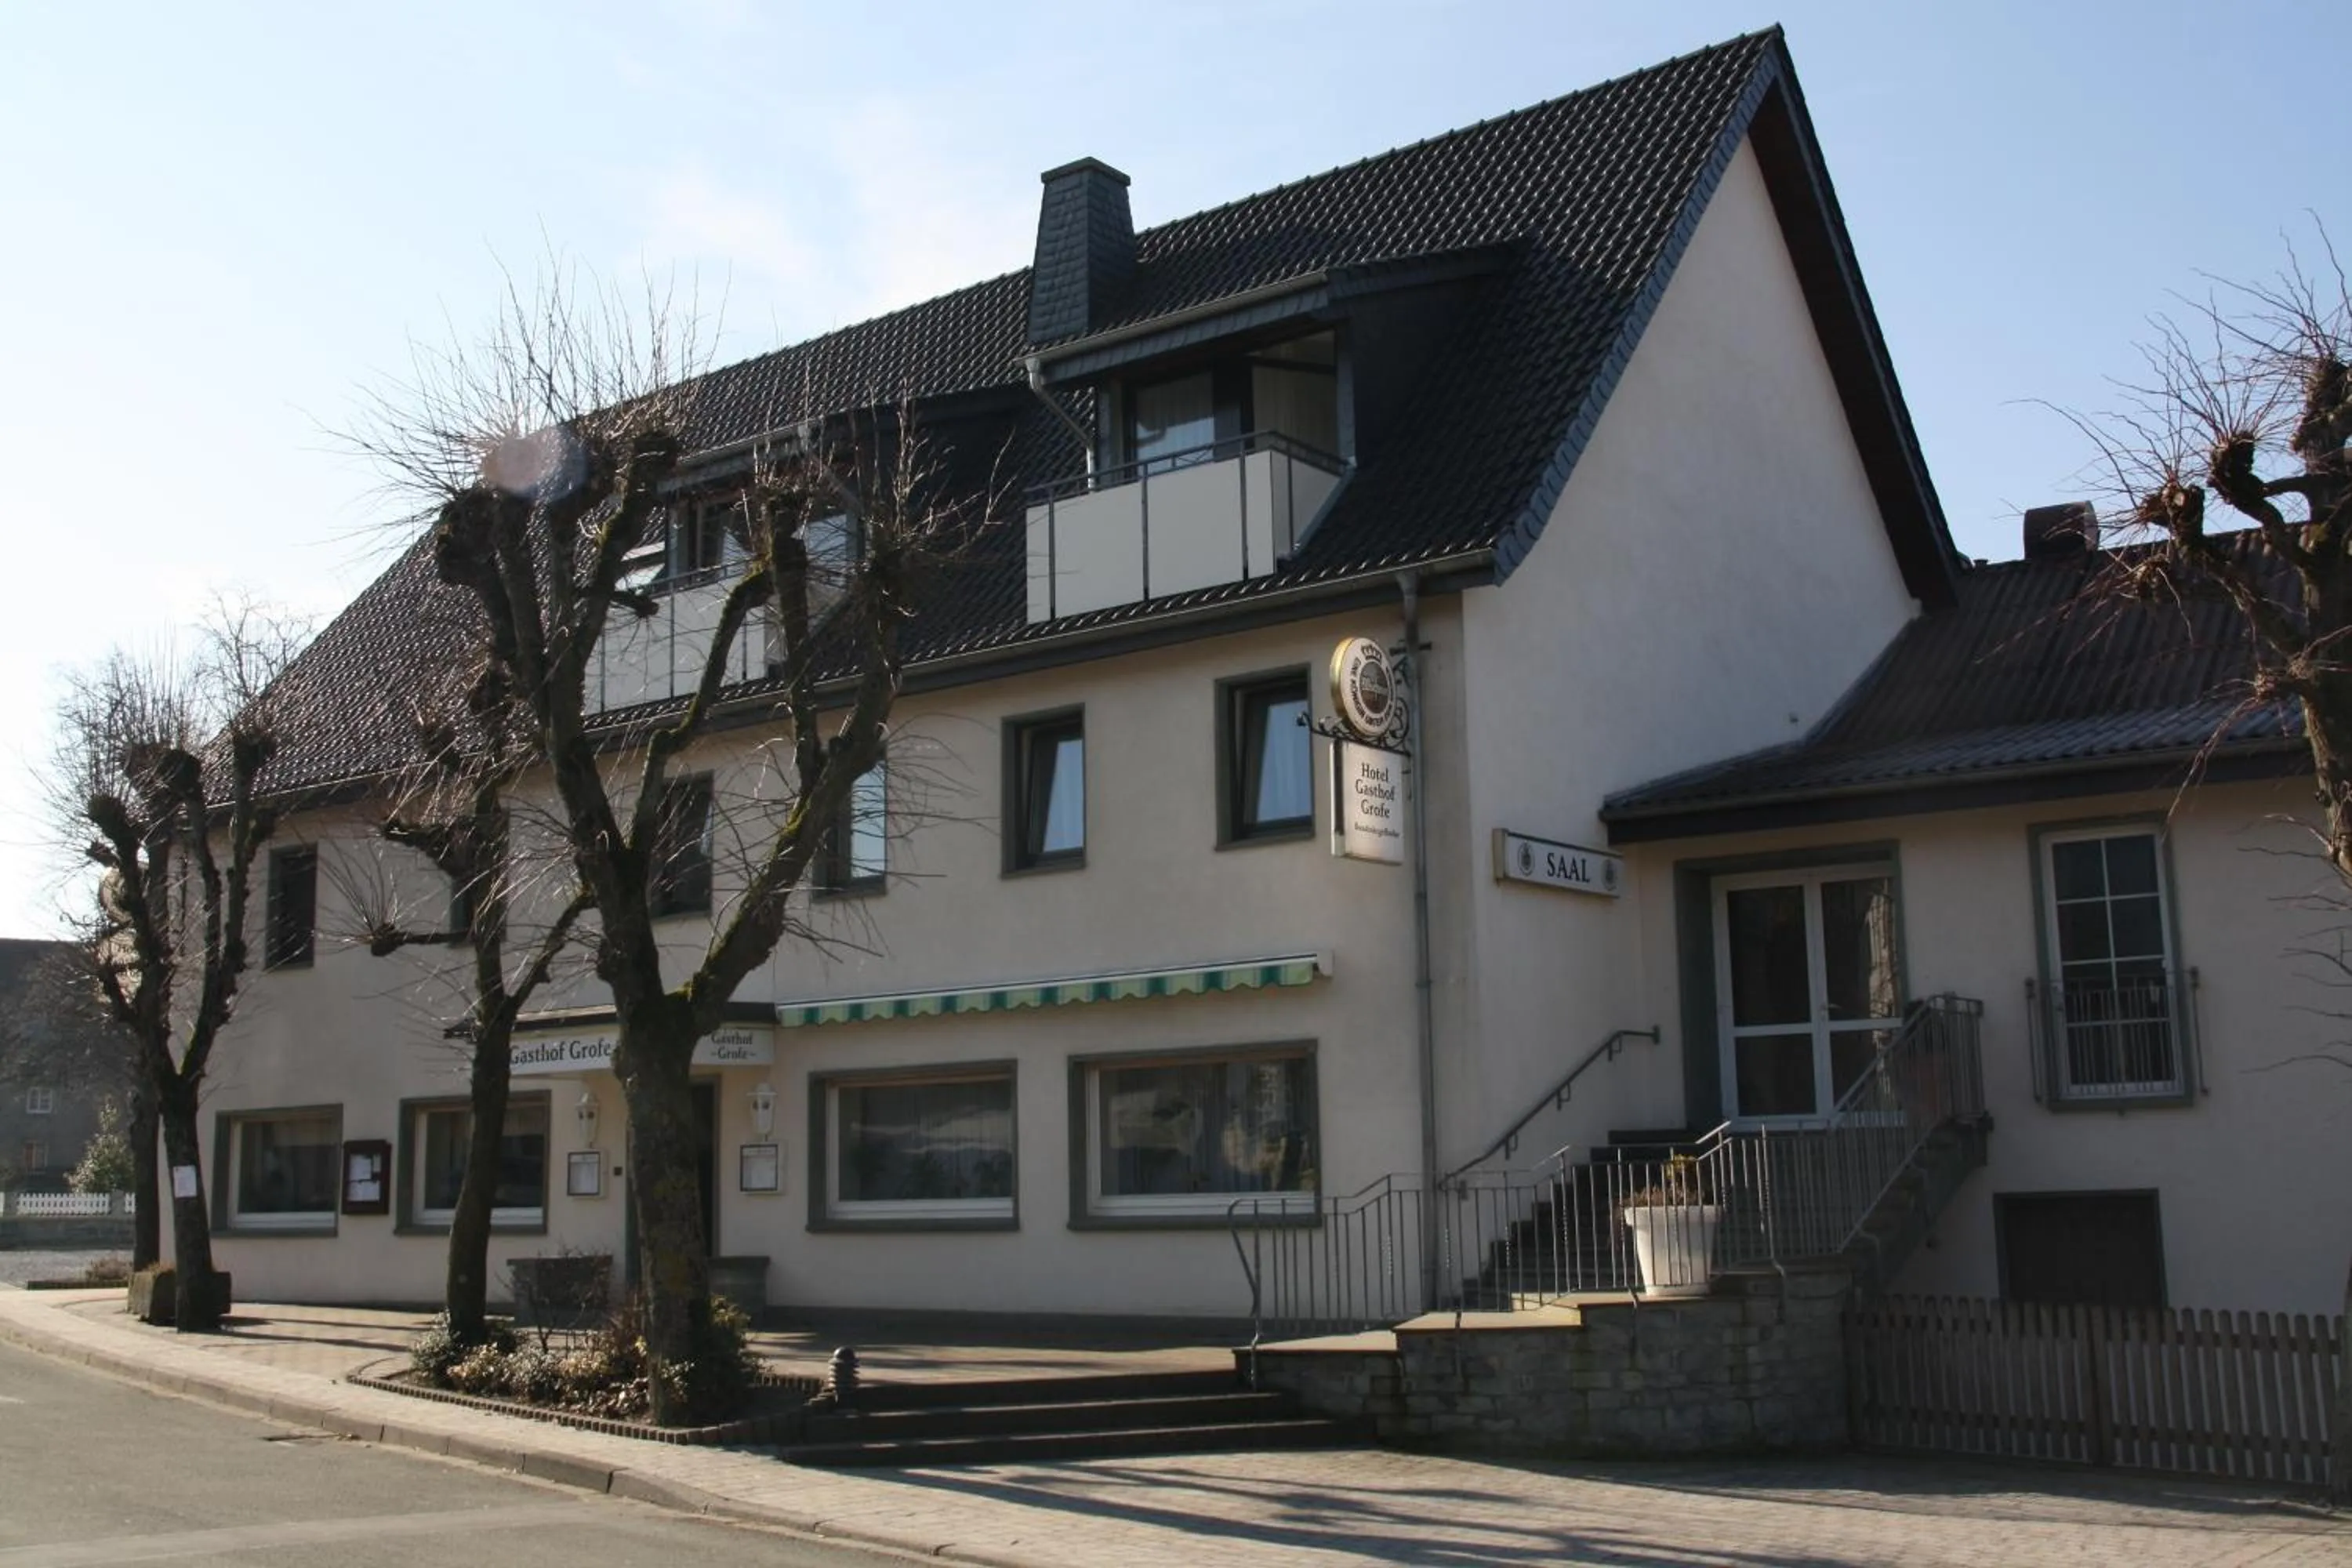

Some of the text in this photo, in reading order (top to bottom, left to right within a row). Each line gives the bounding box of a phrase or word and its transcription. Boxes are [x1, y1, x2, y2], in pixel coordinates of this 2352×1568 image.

[1361, 761, 1389, 782] Hotel
[1355, 779, 1396, 801] Gasthof
[1360, 799, 1391, 818] Grofe
[1547, 852, 1590, 883] SAAL
[711, 1030, 753, 1045] Gasthof
[510, 1036, 612, 1065] Gasthof Grofe
